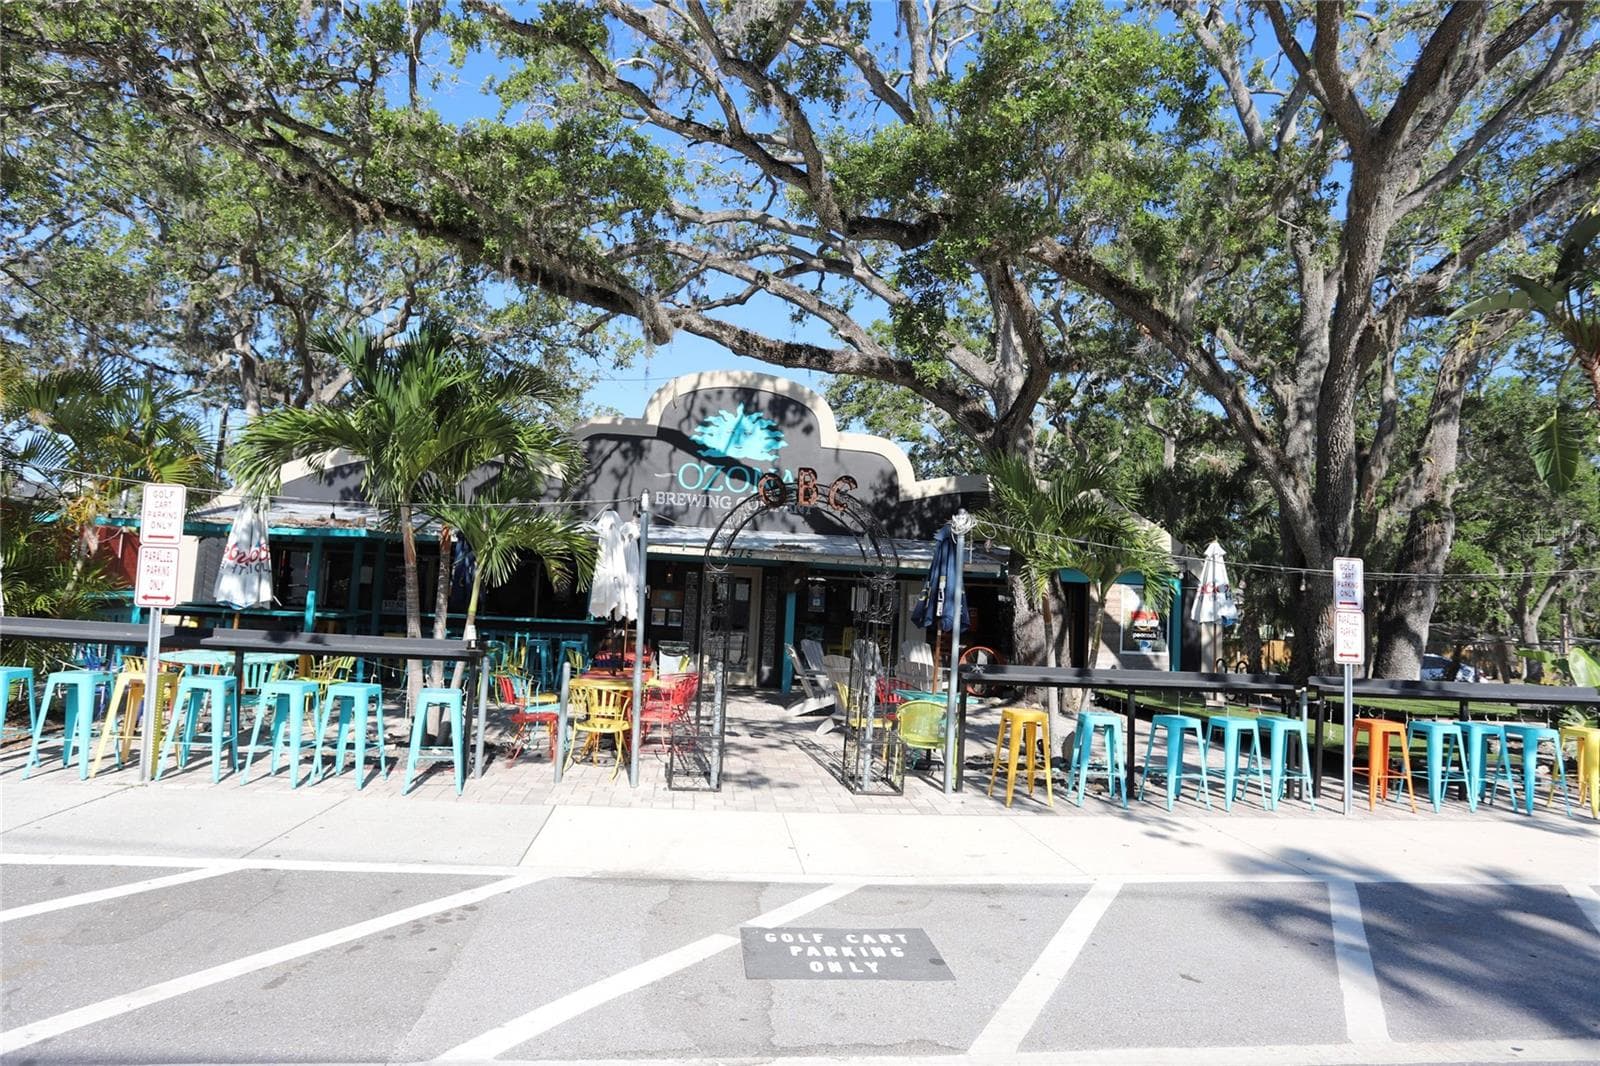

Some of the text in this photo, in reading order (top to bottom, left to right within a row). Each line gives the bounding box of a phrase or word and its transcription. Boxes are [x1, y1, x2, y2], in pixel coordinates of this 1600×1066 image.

[757, 466, 858, 512] OBC
[152, 490, 175, 499] GOLF
[154, 500, 172, 508] CART
[655, 491, 732, 510] BREWING
[147, 511, 178, 520] PARKING
[151, 521, 173, 530] ONLY
[144, 550, 174, 563] PARALLEL
[146, 565, 170, 576] PARKING
[1339, 563, 1355, 571] GOLF
[1341, 572, 1355, 580] CART
[149, 579, 164, 590] ONLY
[1337, 581, 1359, 589] PARKING
[1340, 590, 1356, 598] ONLY
[765, 933, 908, 945] GOLF CART
[790, 946, 905, 958] PARKING
[810, 961, 878, 974] ONLY
